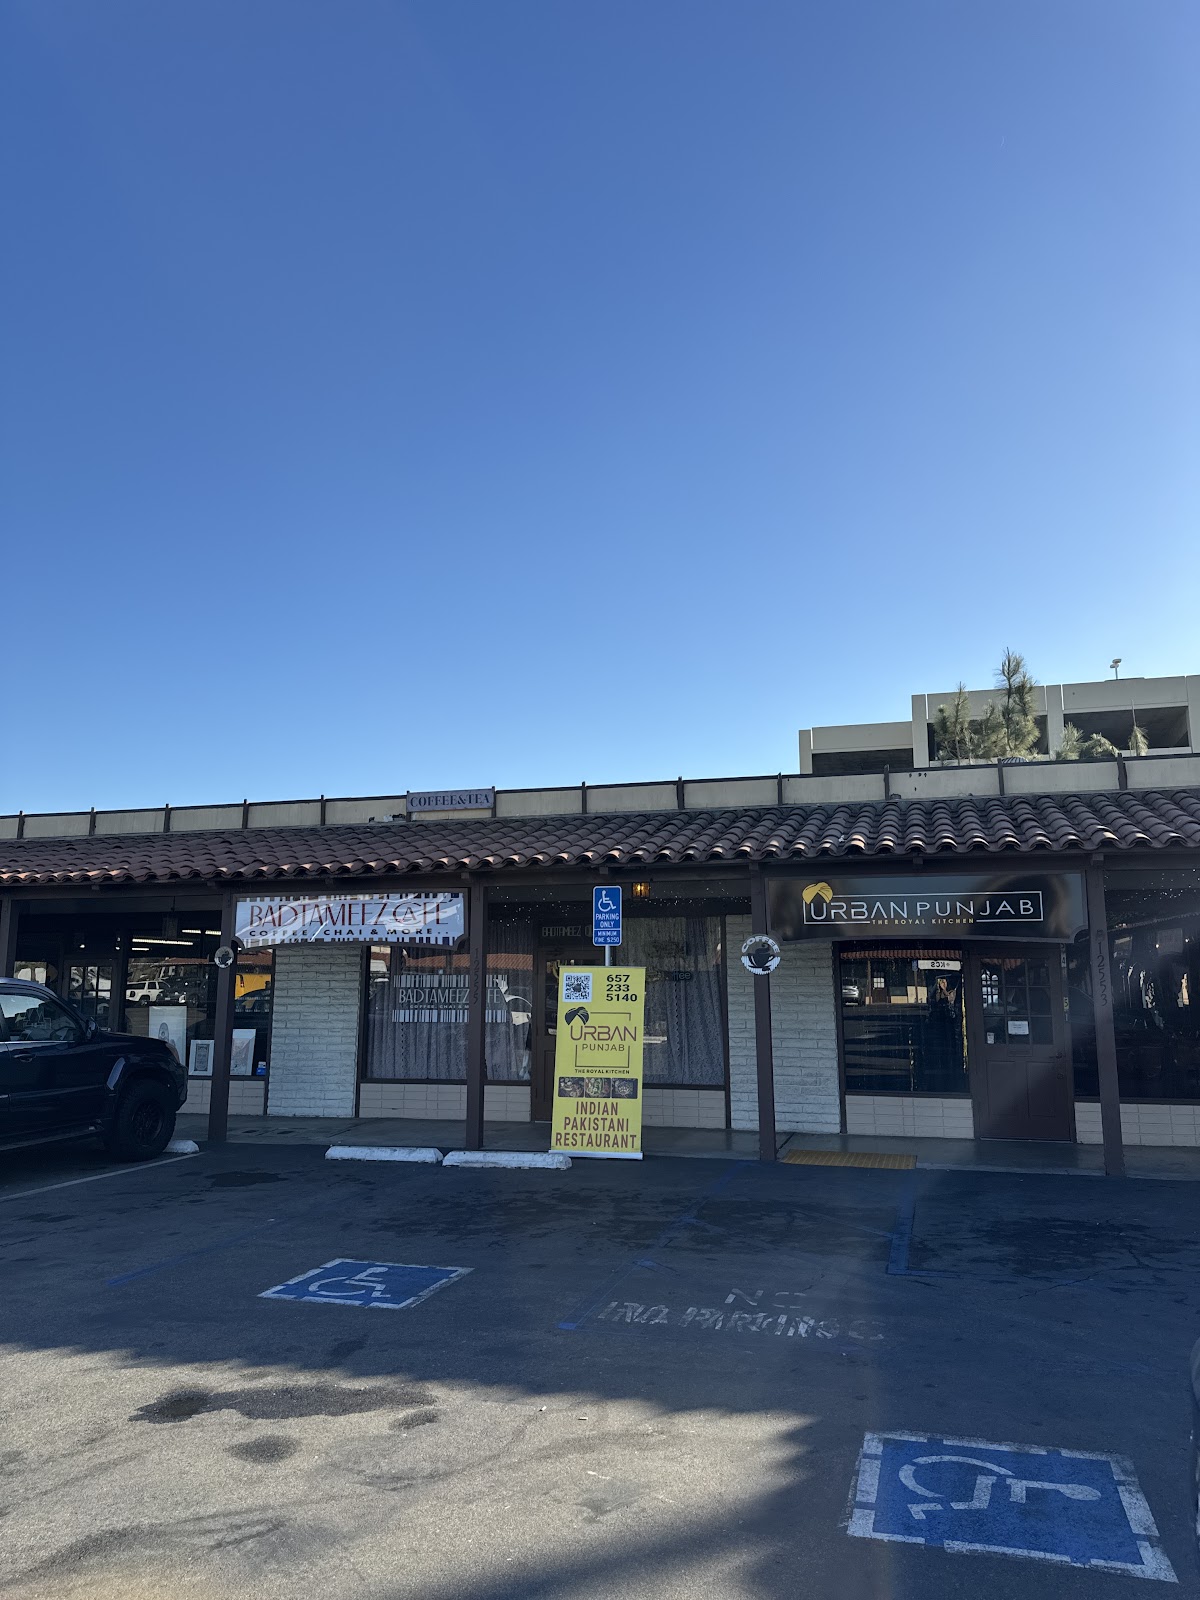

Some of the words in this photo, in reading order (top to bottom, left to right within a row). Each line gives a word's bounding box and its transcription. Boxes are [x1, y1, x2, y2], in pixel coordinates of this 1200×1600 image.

[250, 902, 388, 928] BADTAMEEZ
[595, 913, 620, 921] PARKING
[810, 901, 907, 920] URBAN
[916, 899, 1034, 917] PUNJAB
[323, 928, 362, 936] CHAI
[741, 935, 780, 953] COFFEE
[606, 974, 630, 983] 657
[606, 983, 630, 992] 233
[399, 988, 470, 1004] BADTAMEEZ
[606, 993, 638, 1002] 5140
[570, 1025, 637, 1041] URBAN
[581, 1043, 625, 1052] PUNJAB
[576, 1101, 618, 1116] INDIAN
[563, 1116, 629, 1132] PAKISTANI
[555, 1132, 637, 1149] RESTAURANT
